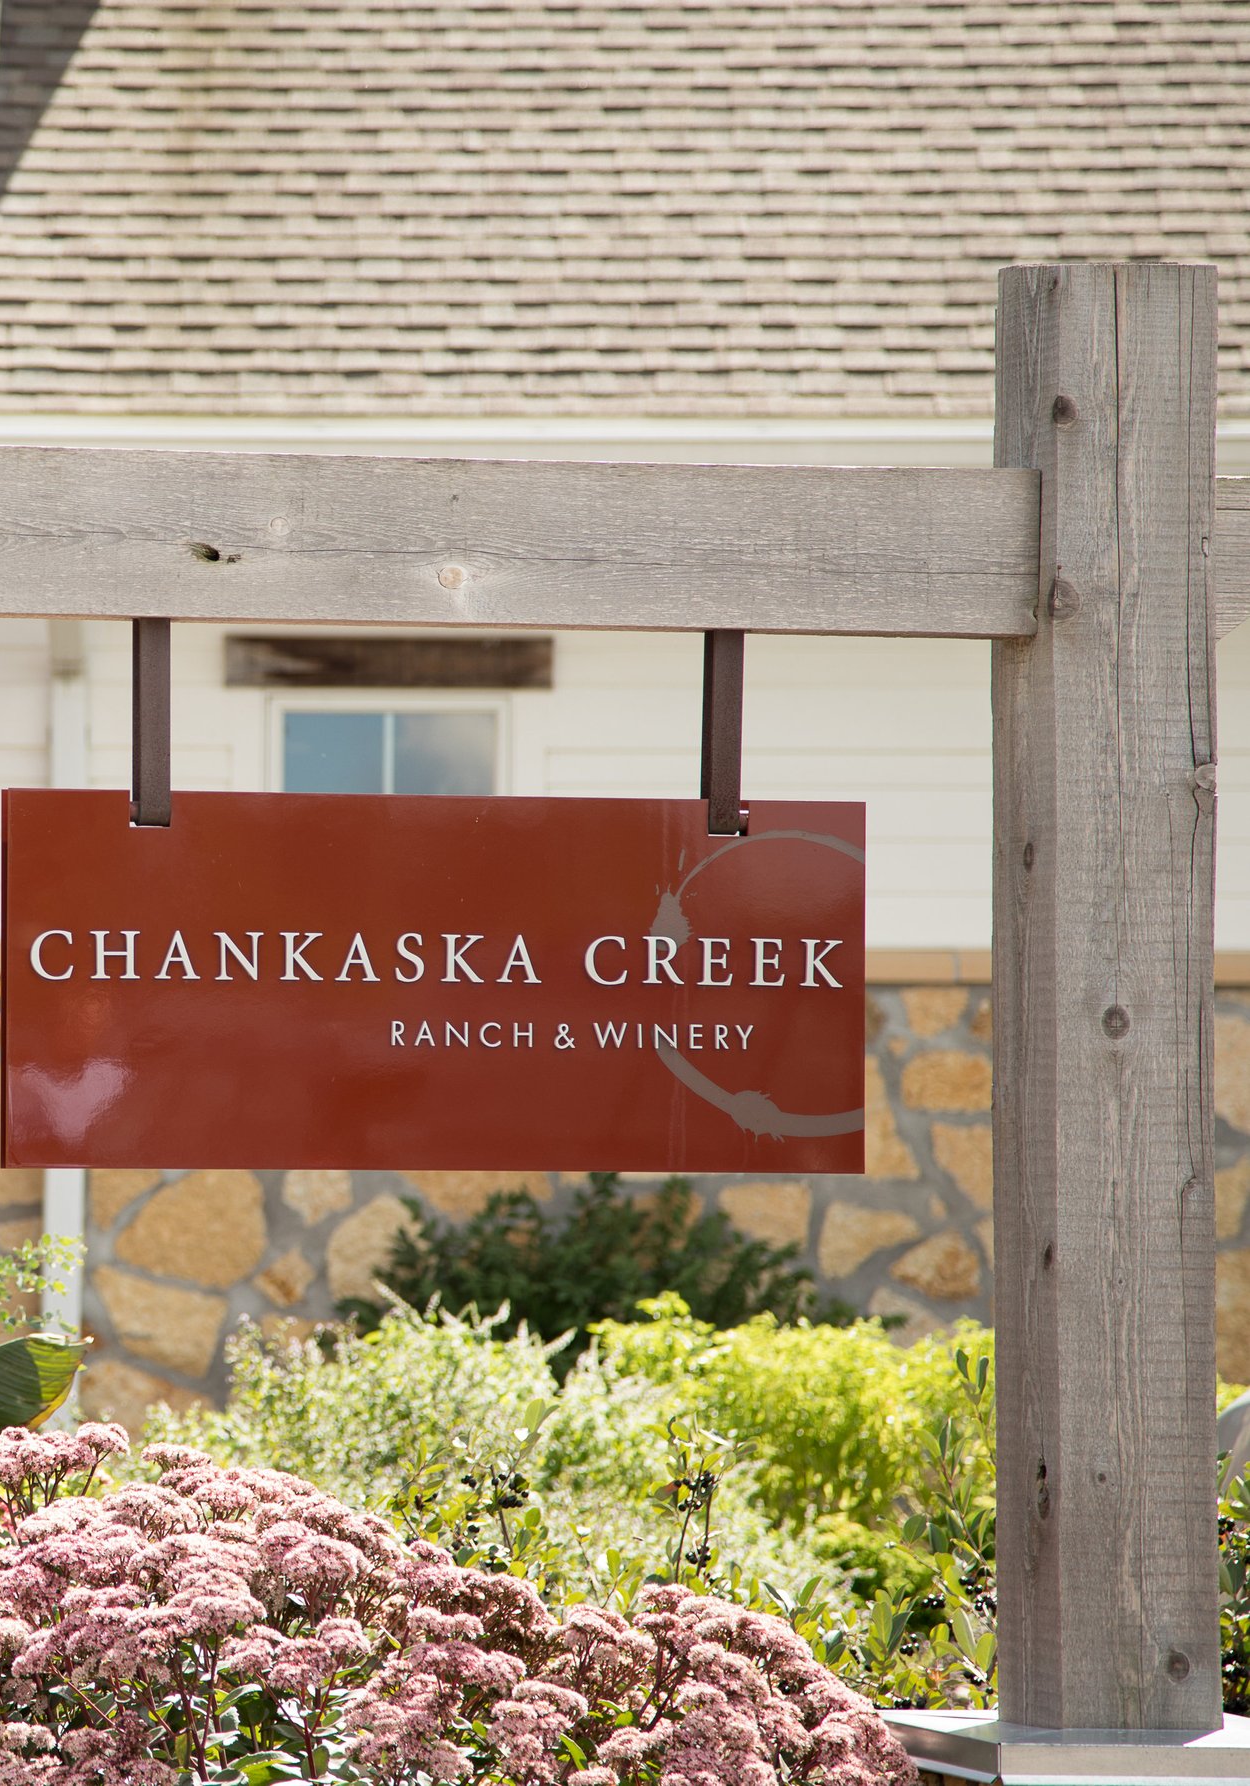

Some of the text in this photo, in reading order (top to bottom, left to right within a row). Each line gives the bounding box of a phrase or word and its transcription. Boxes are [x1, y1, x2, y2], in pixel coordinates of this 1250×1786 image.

[29, 929, 844, 988] CHANKASKA CREEK
[390, 1020, 755, 1050] RANCH & WINERY
